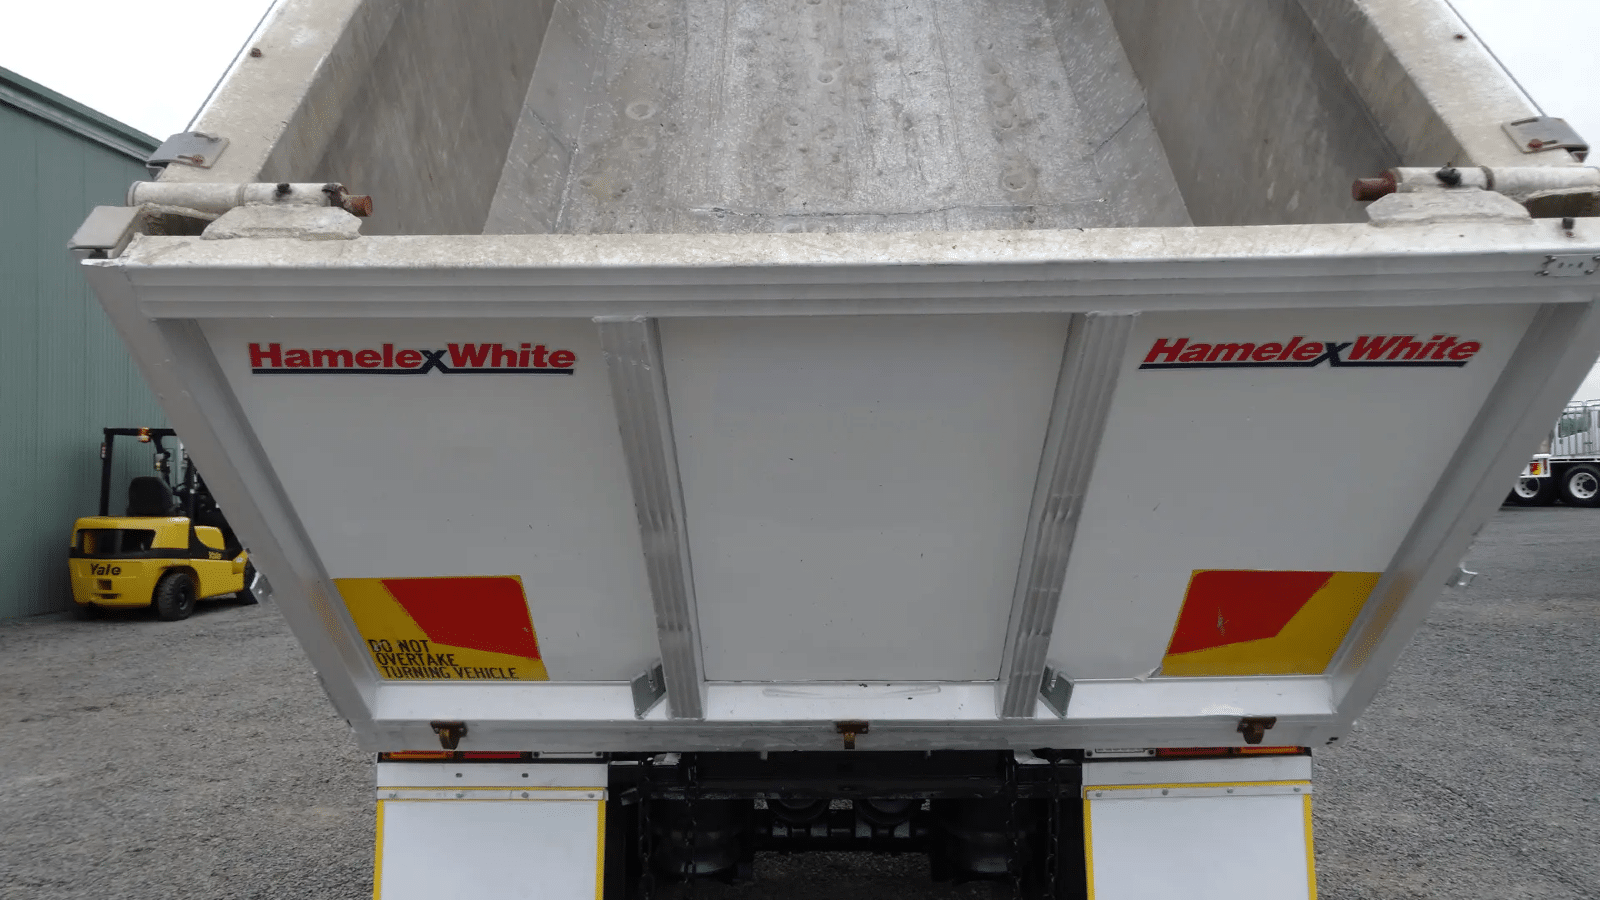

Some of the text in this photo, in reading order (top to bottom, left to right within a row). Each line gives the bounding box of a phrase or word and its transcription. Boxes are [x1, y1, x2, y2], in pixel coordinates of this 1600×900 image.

[90, 563, 121, 576] Yale
[368, 639, 429, 653] DO NOT
[375, 652, 459, 666] OVERTAKE
[381, 665, 519, 680] TURNING VEHICLE
